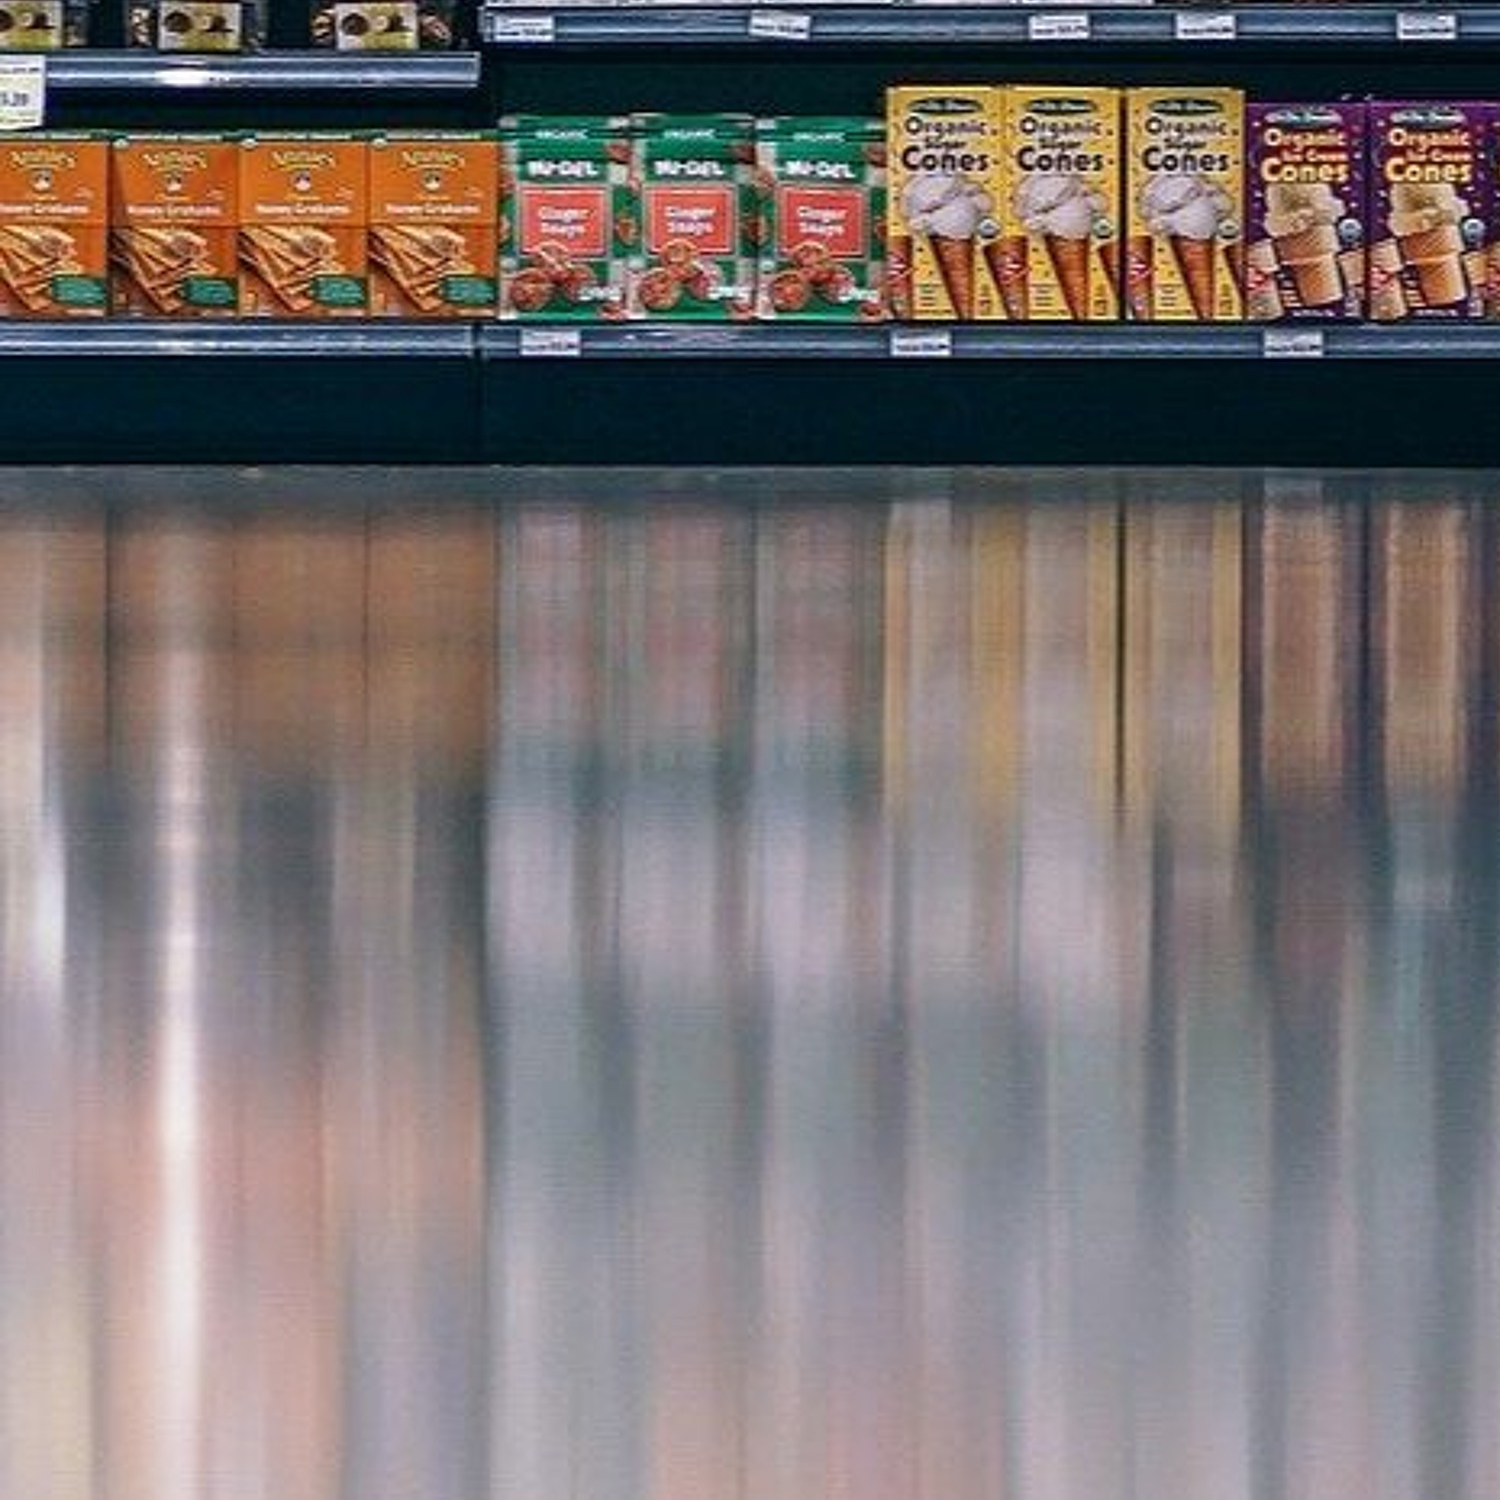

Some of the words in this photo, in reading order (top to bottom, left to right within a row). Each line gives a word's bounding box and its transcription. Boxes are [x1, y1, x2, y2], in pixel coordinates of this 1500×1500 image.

[905, 117, 987, 141] Organic
[1021, 117, 1102, 141] Organic
[1145, 117, 1226, 141] Organic
[1264, 128, 1346, 151] Organic
[1388, 128, 1470, 151] Organic
[903, 146, 988, 171] Cones
[1018, 146, 1103, 171] Cones
[1143, 146, 1228, 171] Cones
[1261, 158, 1348, 182] Cones
[1385, 158, 1472, 182] Cones
